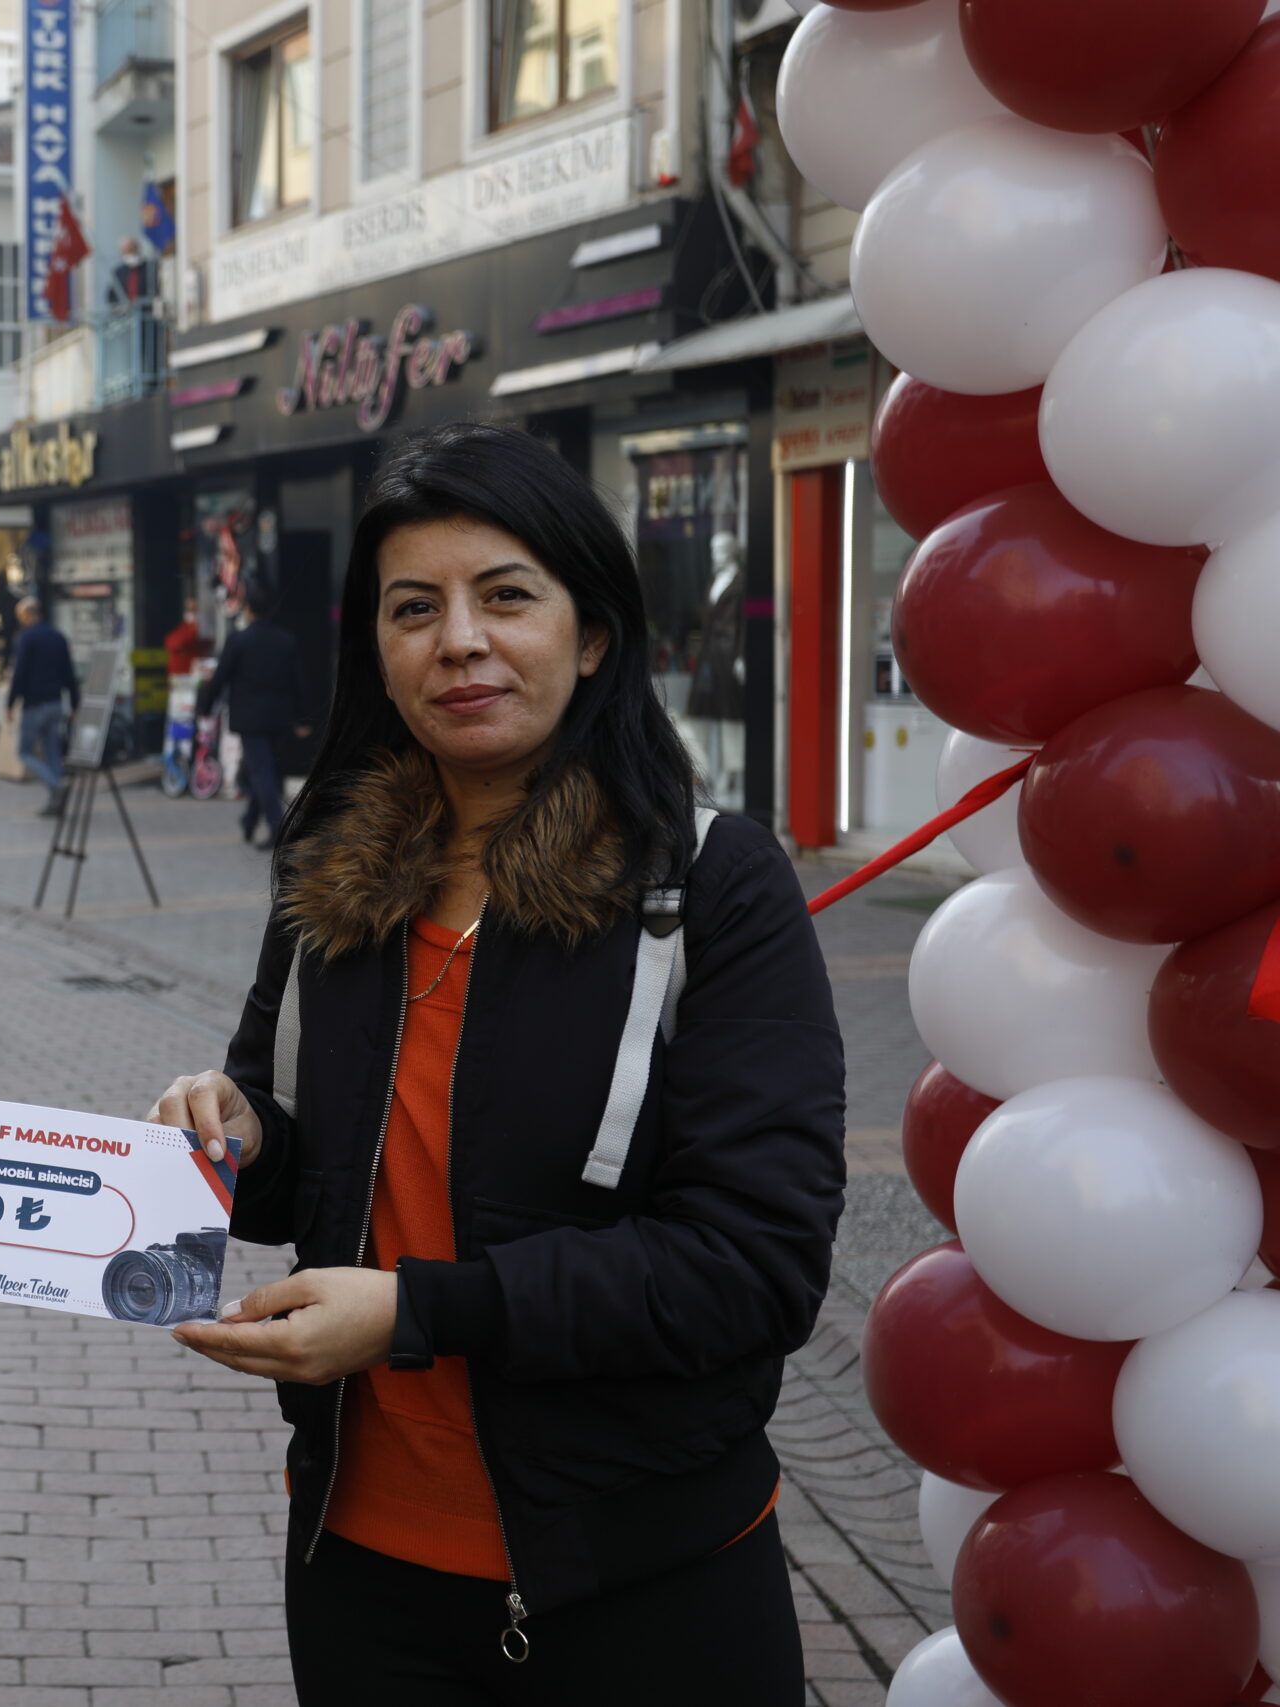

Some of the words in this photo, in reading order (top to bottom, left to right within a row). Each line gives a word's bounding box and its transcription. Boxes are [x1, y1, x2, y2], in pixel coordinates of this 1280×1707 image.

[32, 103, 68, 190] HAVA
[276, 304, 471, 432] Nilüfer
[15, 1127, 131, 1157] MARATONU
[38, 1169, 94, 1189] BİRİNCİSİ
[29, 1278, 70, 1298] Taban
